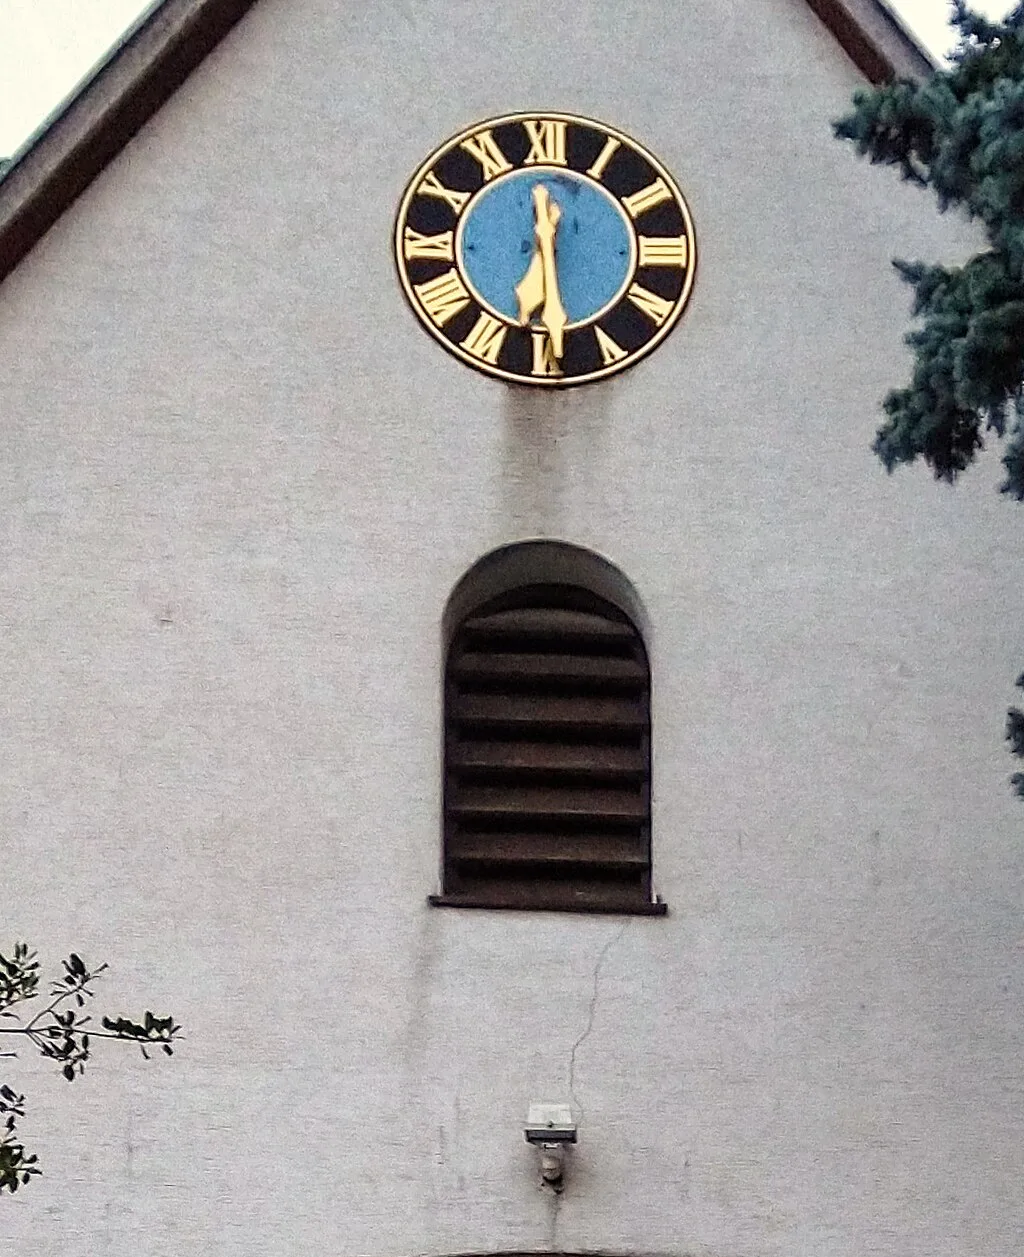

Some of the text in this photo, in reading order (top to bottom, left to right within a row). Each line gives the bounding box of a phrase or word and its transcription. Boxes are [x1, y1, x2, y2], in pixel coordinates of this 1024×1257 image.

[460, 130, 514, 181] XI
[523, 120, 567, 165] XII
[417, 170, 472, 214] X
[621, 176, 674, 218] II
[404, 226, 454, 261] IX
[638, 234, 687, 269] III
[413, 267, 471, 329] VIII
[626, 282, 676, 328] IV
[459, 311, 508, 365] VII
[593, 324, 629, 365] V
